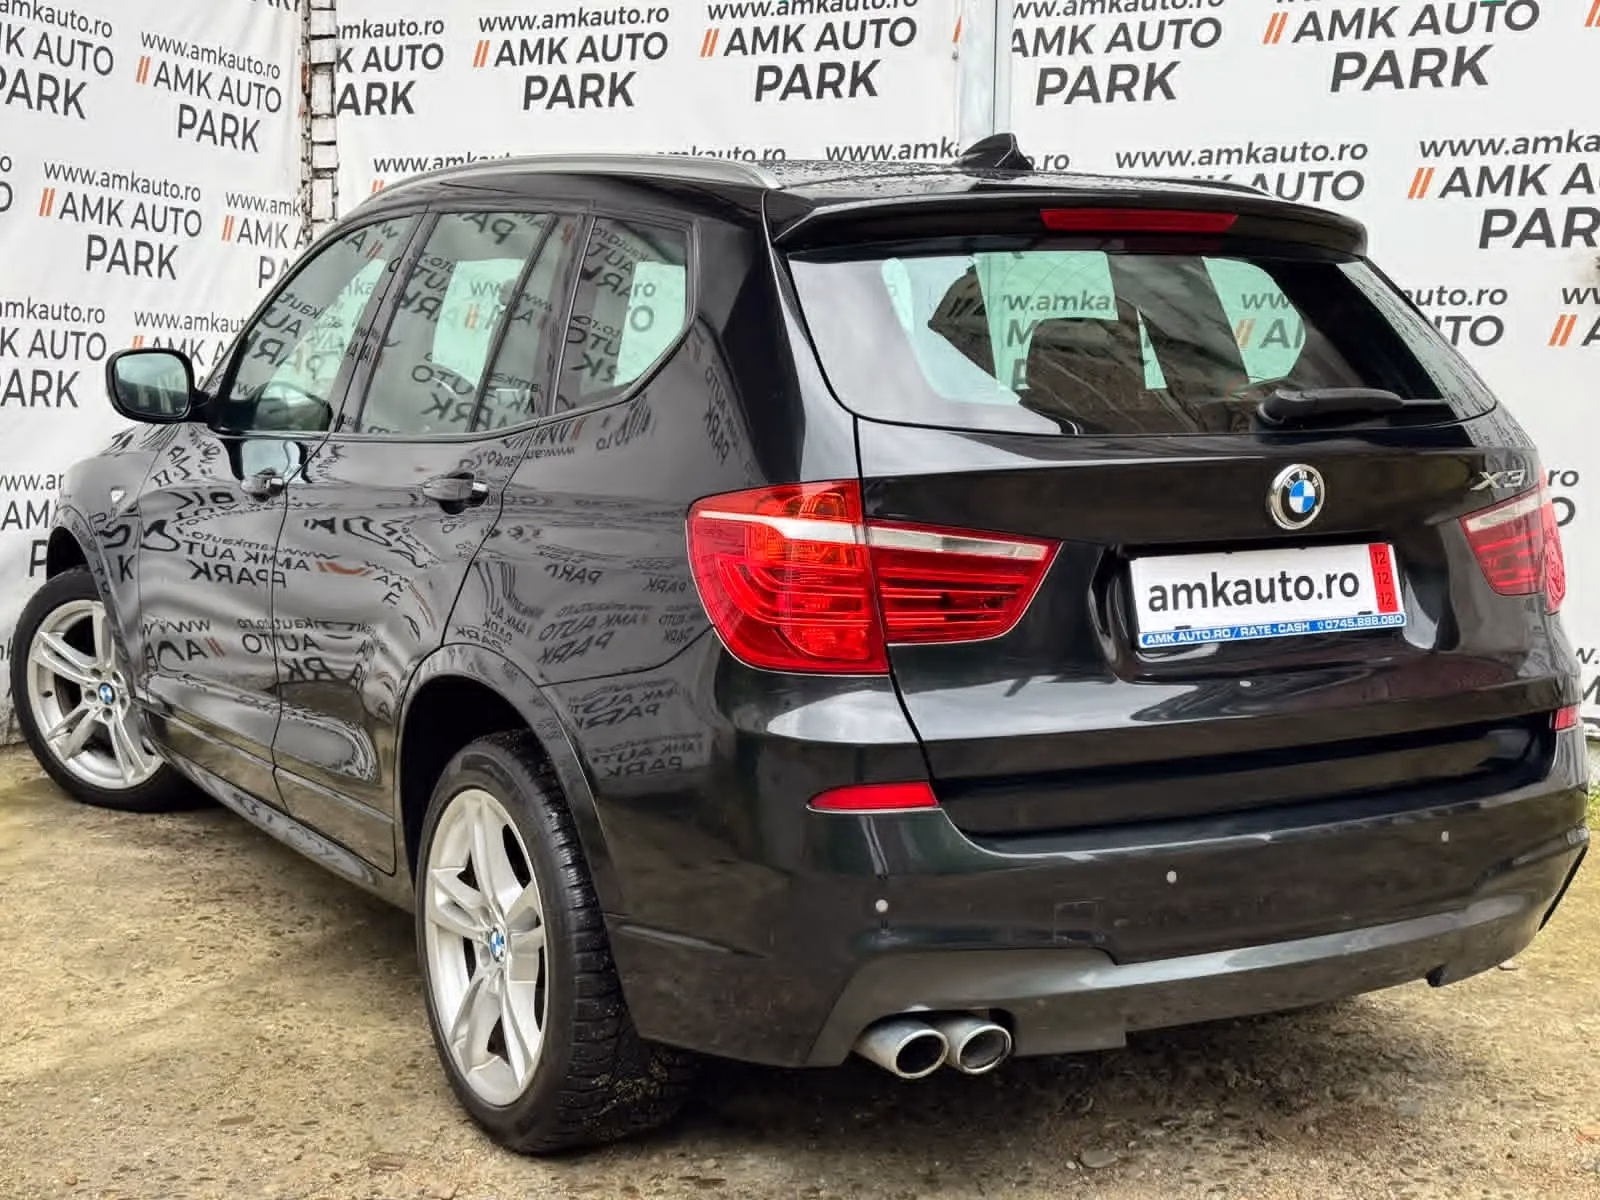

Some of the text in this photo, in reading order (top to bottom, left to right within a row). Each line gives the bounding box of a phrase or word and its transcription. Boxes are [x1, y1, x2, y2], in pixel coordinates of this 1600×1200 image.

[479, 6, 670, 33] www.amkauto.ro
[724, 16, 917, 57] AMK AUTO
[1012, 17, 1222, 58] AMK AUTO
[1292, 0, 1540, 43] AMK AUTO
[0, 22, 114, 76] K AUTO
[141, 31, 281, 80] www.amkauto.ro
[361, 43, 444, 73] AUTO
[494, 31, 669, 68] AMK AUTO
[1330, 44, 1494, 93] PARK
[153, 60, 282, 113] AMK AUTO
[337, 80, 416, 116] ARK
[523, 71, 638, 111] PARK
[755, 59, 881, 103] PARK
[1035, 61, 1181, 106] PARK
[178, 103, 260, 153] PARK
[1115, 142, 1368, 168] www.amkauto.ro
[43, 161, 200, 202] www.amkauto.ro
[1438, 162, 1600, 198] AMK A
[58, 191, 202, 238] AMK AUTO
[237, 217, 288, 249] AMK
[1479, 206, 1600, 249] PAR
[85, 234, 179, 280] PARK
[0, 296, 105, 324] mkauto.ro
[0, 326, 106, 361] K AUTO
[0, 368, 80, 408] ARK
[1471, 469, 1525, 490] X3
[1373, 551, 1387, 565] 12
[1377, 571, 1391, 585] 12
[1149, 571, 1360, 612] amkauto.ro
[1146, 632, 1175, 645] AMK
[1178, 628, 1231, 642] AUTO.RO
